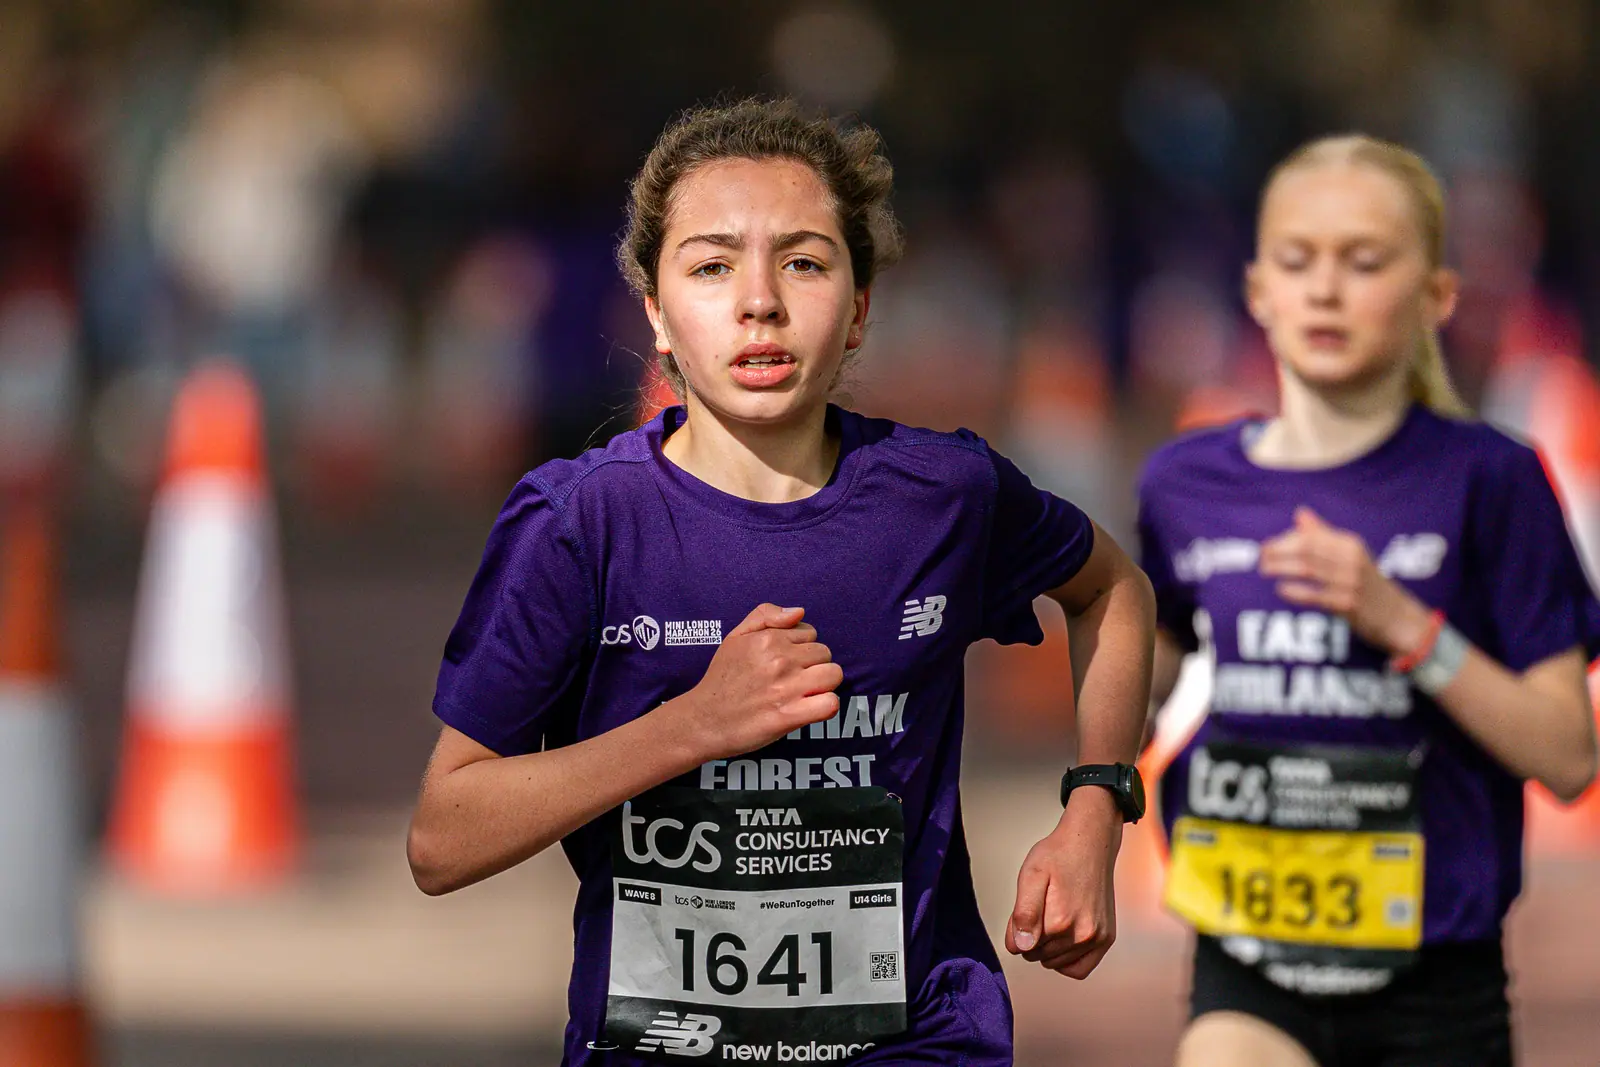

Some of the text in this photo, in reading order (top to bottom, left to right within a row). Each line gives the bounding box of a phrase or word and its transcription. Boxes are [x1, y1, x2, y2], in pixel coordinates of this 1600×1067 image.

[664, 620, 721, 630] MINI LONDON
[898, 594, 947, 640] NB
[601, 624, 632, 645] cs
[664, 628, 722, 638] MARATHON 26
[666, 636, 721, 645] CHAMPIONSHIPS
[700, 754, 876, 791] FOREST
[735, 808, 802, 826] TATA
[622, 800, 722, 873] tcs
[735, 828, 890, 851] CONSULTANCY
[735, 853, 832, 875] SERVICES
[624, 889, 650, 900] WAVE
[760, 898, 835, 909] #WeRunTogether
[854, 894, 892, 904] U14 Girls
[1219, 865, 1363, 931] 1833
[675, 928, 833, 997] 1641
[635, 1010, 722, 1057] NB
[722, 1041, 876, 1062] new balanc
